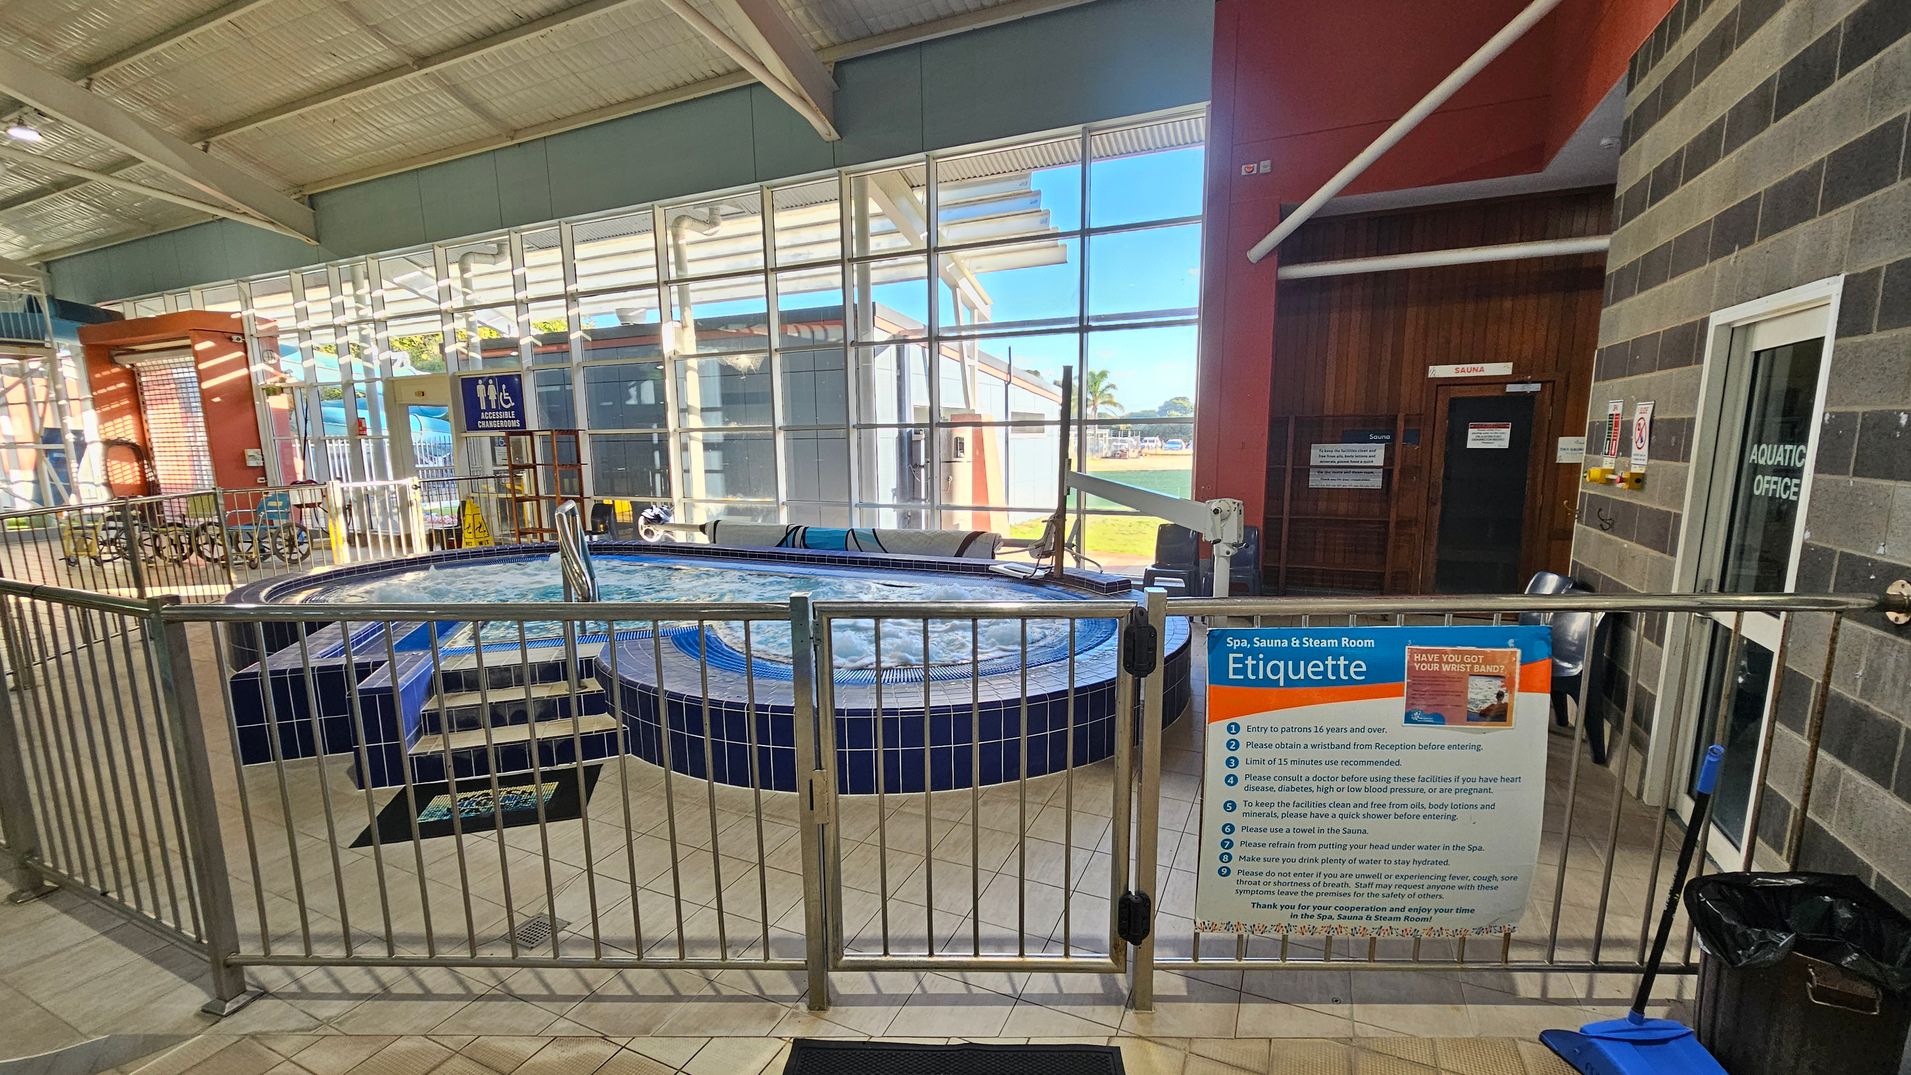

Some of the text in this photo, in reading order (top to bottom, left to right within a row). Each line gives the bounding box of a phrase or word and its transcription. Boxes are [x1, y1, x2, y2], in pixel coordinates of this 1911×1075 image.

[1454, 366, 1485, 374] SAUNA
[481, 411, 516, 419] ACCESSIBLE
[478, 420, 520, 428] CHANGEROOMS
[1749, 444, 1806, 468] AQUATIC
[1753, 474, 1800, 501] OFFICE
[1226, 637, 1374, 649] Spa, Sauna & Steam Room
[1414, 654, 1484, 663] HAVE YOU GOT
[1228, 653, 1367, 686] Etiquette
[1414, 663, 1505, 673] YOUR WRIST BAND?
[1246, 725, 1268, 734] Entry
[1280, 726, 1311, 734] patrons
[1314, 725, 1324, 733] 16
[1349, 725, 1365, 733] and
[1246, 741, 1273, 749] Please
[1274, 741, 1301, 749] obtain
[1310, 741, 1351, 749] wristband
[1353, 741, 1372, 749] from
[1374, 742, 1416, 751] Reception
[1418, 742, 1445, 750] before
[1447, 742, 1483, 752] entering.
[1245, 757, 1265, 765] Limit
[1267, 757, 1276, 765] of
[1340, 758, 1401, 766] recommended.
[1244, 773, 1271, 781] Please
[1312, 774, 1339, 782] doctor
[1341, 774, 1367, 782] before
[1369, 775, 1391, 784] using
[1417, 775, 1452, 783] facilities
[1500, 775, 1521, 783] heart
[1243, 784, 1276, 792] disease,
[1277, 784, 1314, 793] diabetes,
[1316, 785, 1334, 794] high
[1364, 785, 1388, 793] blood
[1454, 787, 1493, 795] pregnant.
[1255, 800, 1275, 809] keep
[1292, 800, 1326, 808] facilities
[1370, 801, 1386, 809] free
[1388, 801, 1408, 809] from
[1410, 801, 1426, 809] oils,
[1428, 802, 1448, 811] body
[1242, 810, 1279, 818] minerals,
[1281, 810, 1307, 819] please
[1338, 811, 1360, 820] quick
[1393, 812, 1420, 820] before
[1422, 813, 1458, 821] entering.
[1241, 825, 1267, 833] Please
[1240, 840, 1266, 848] Please
[1318, 842, 1347, 851] putting
[1452, 843, 1465, 851] the
[1467, 844, 1485, 852] Spa.
[1321, 857, 1346, 865] plenty
[1412, 858, 1450, 867] hydrated.
[1394, 873, 1447, 882] experiencing
[1448, 873, 1470, 881] fever,
[1472, 874, 1499, 882] cough,
[1381, 891, 1405, 900] safety
[1407, 906, 1432, 914] enjoy
[1455, 906, 1475, 914] time
